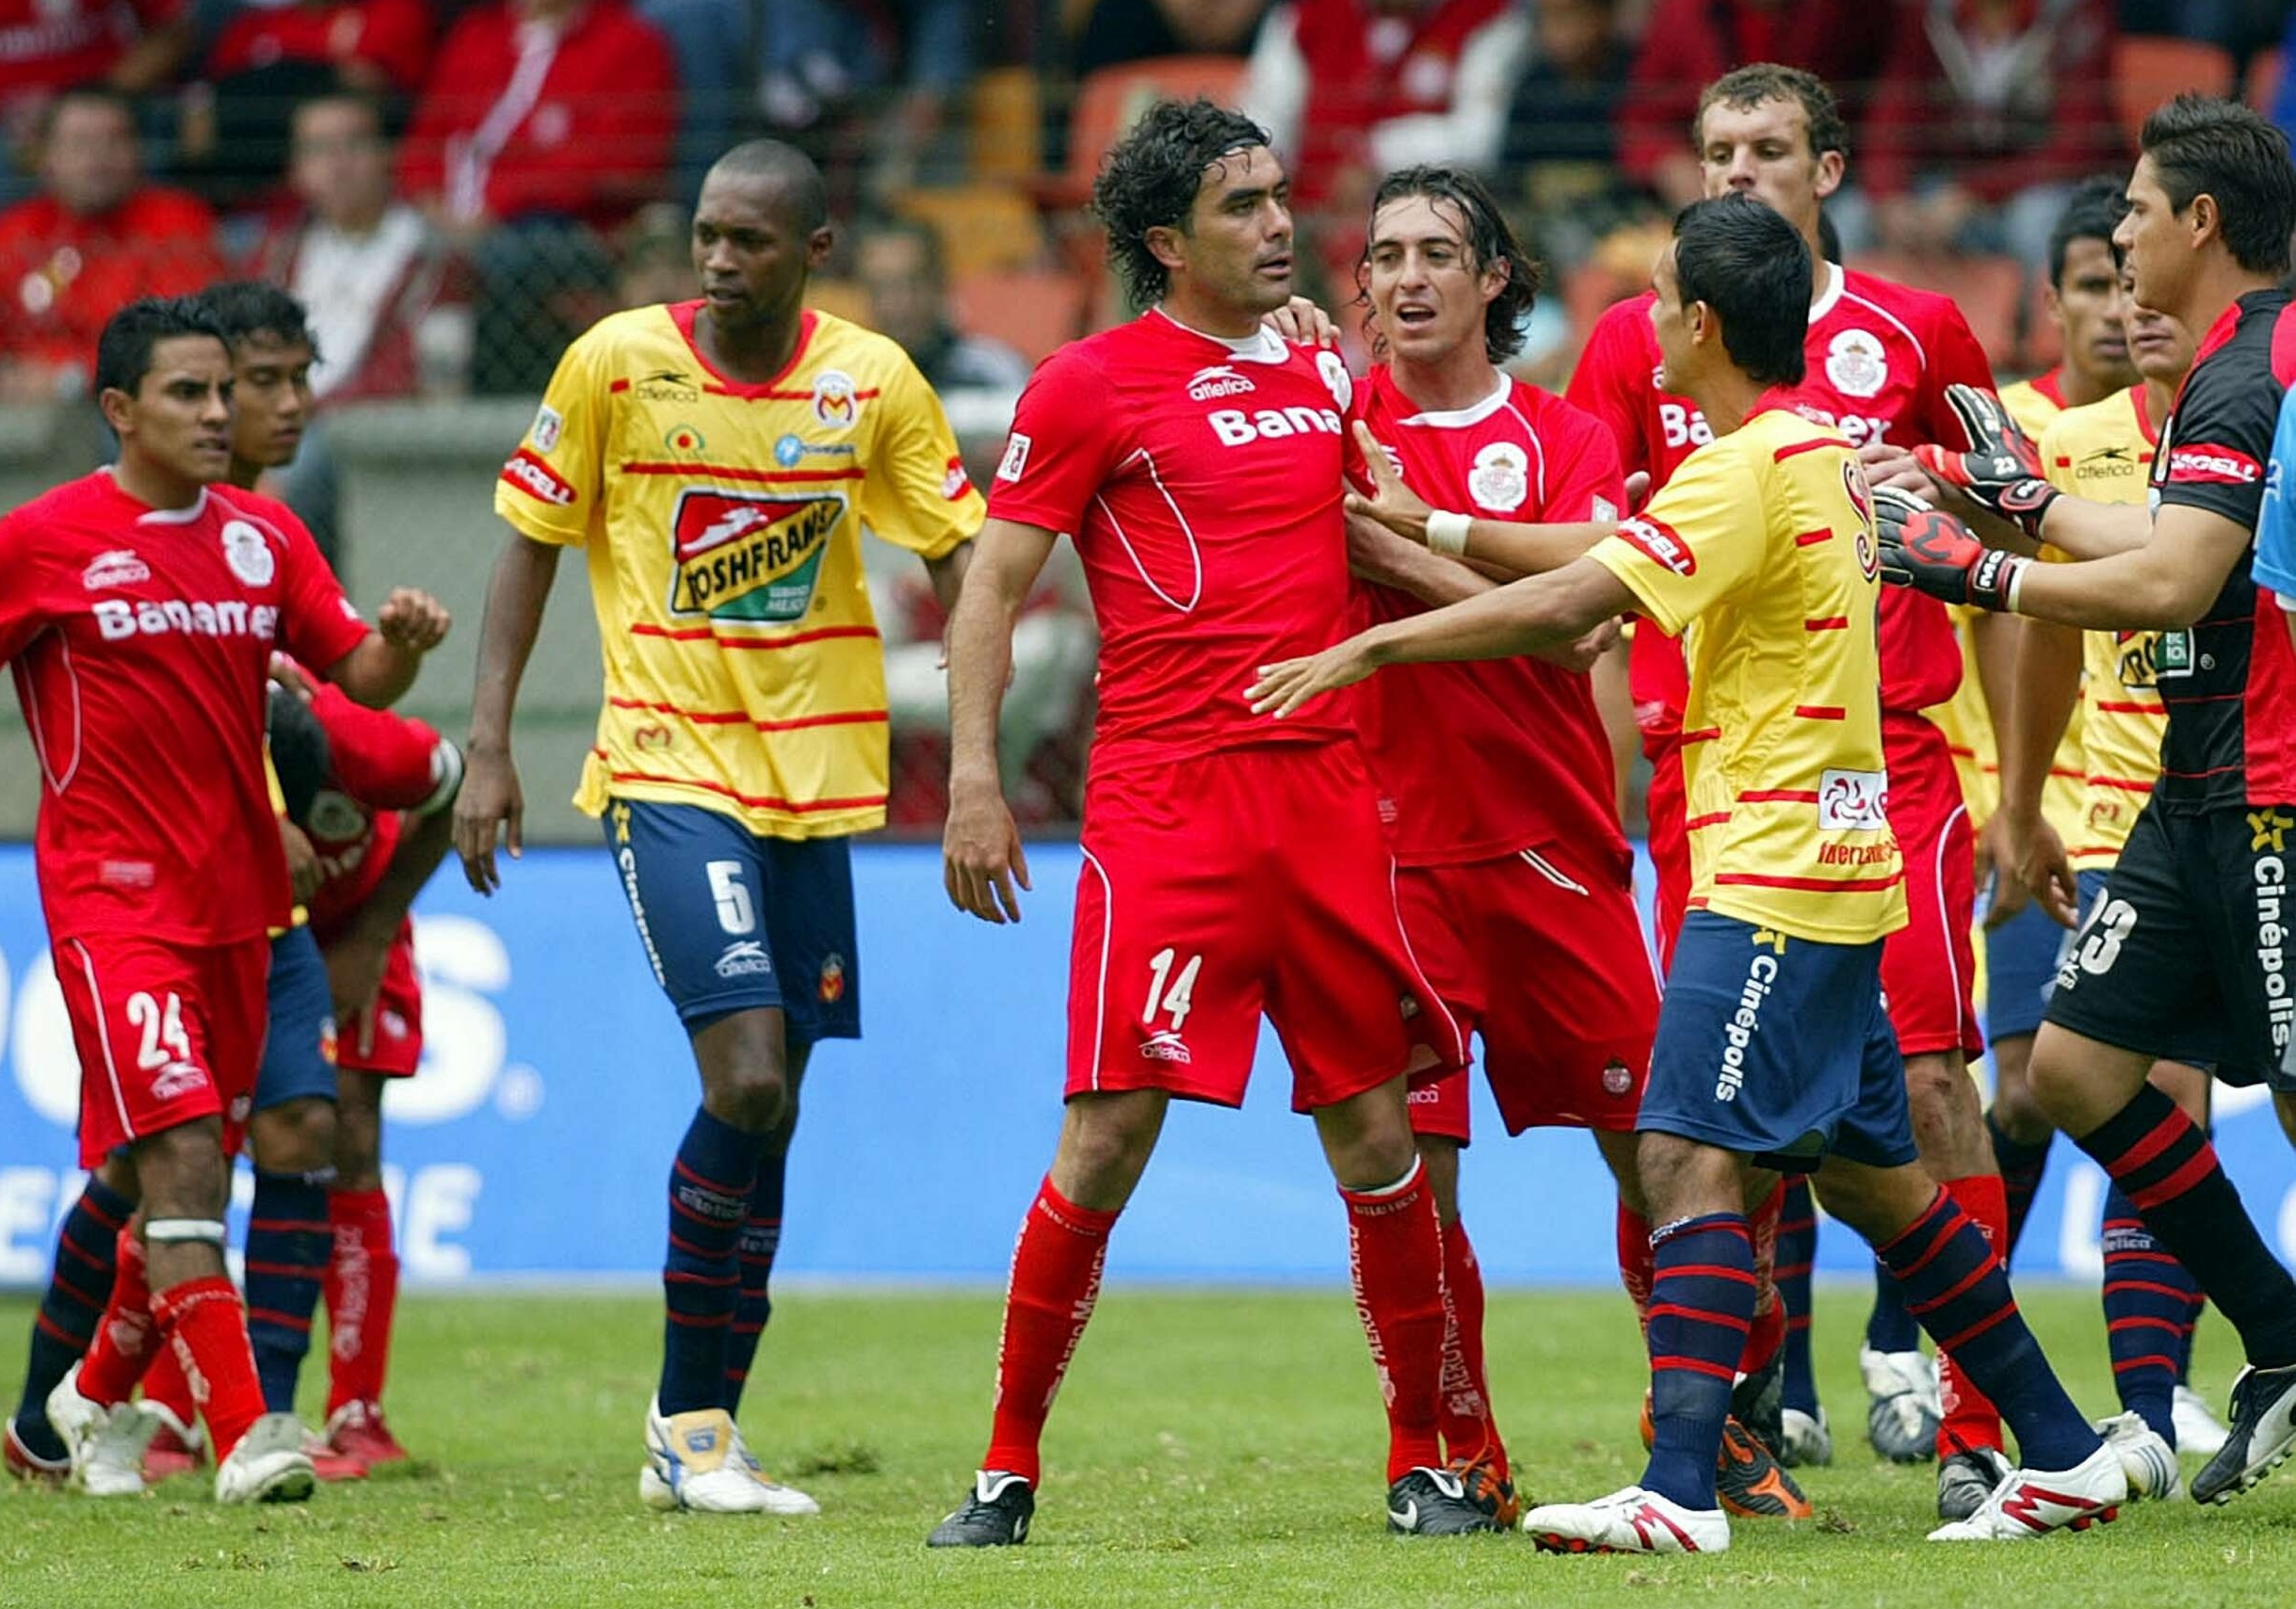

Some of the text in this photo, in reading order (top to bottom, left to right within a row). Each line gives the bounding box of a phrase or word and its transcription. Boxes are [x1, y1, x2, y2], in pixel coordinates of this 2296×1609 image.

[1994, 458, 2017, 475] 23
[2076, 462, 2134, 479] atletica
[706, 861, 755, 935] 5
[1142, 947, 1202, 1030] 14
[126, 990, 192, 1070] 24
